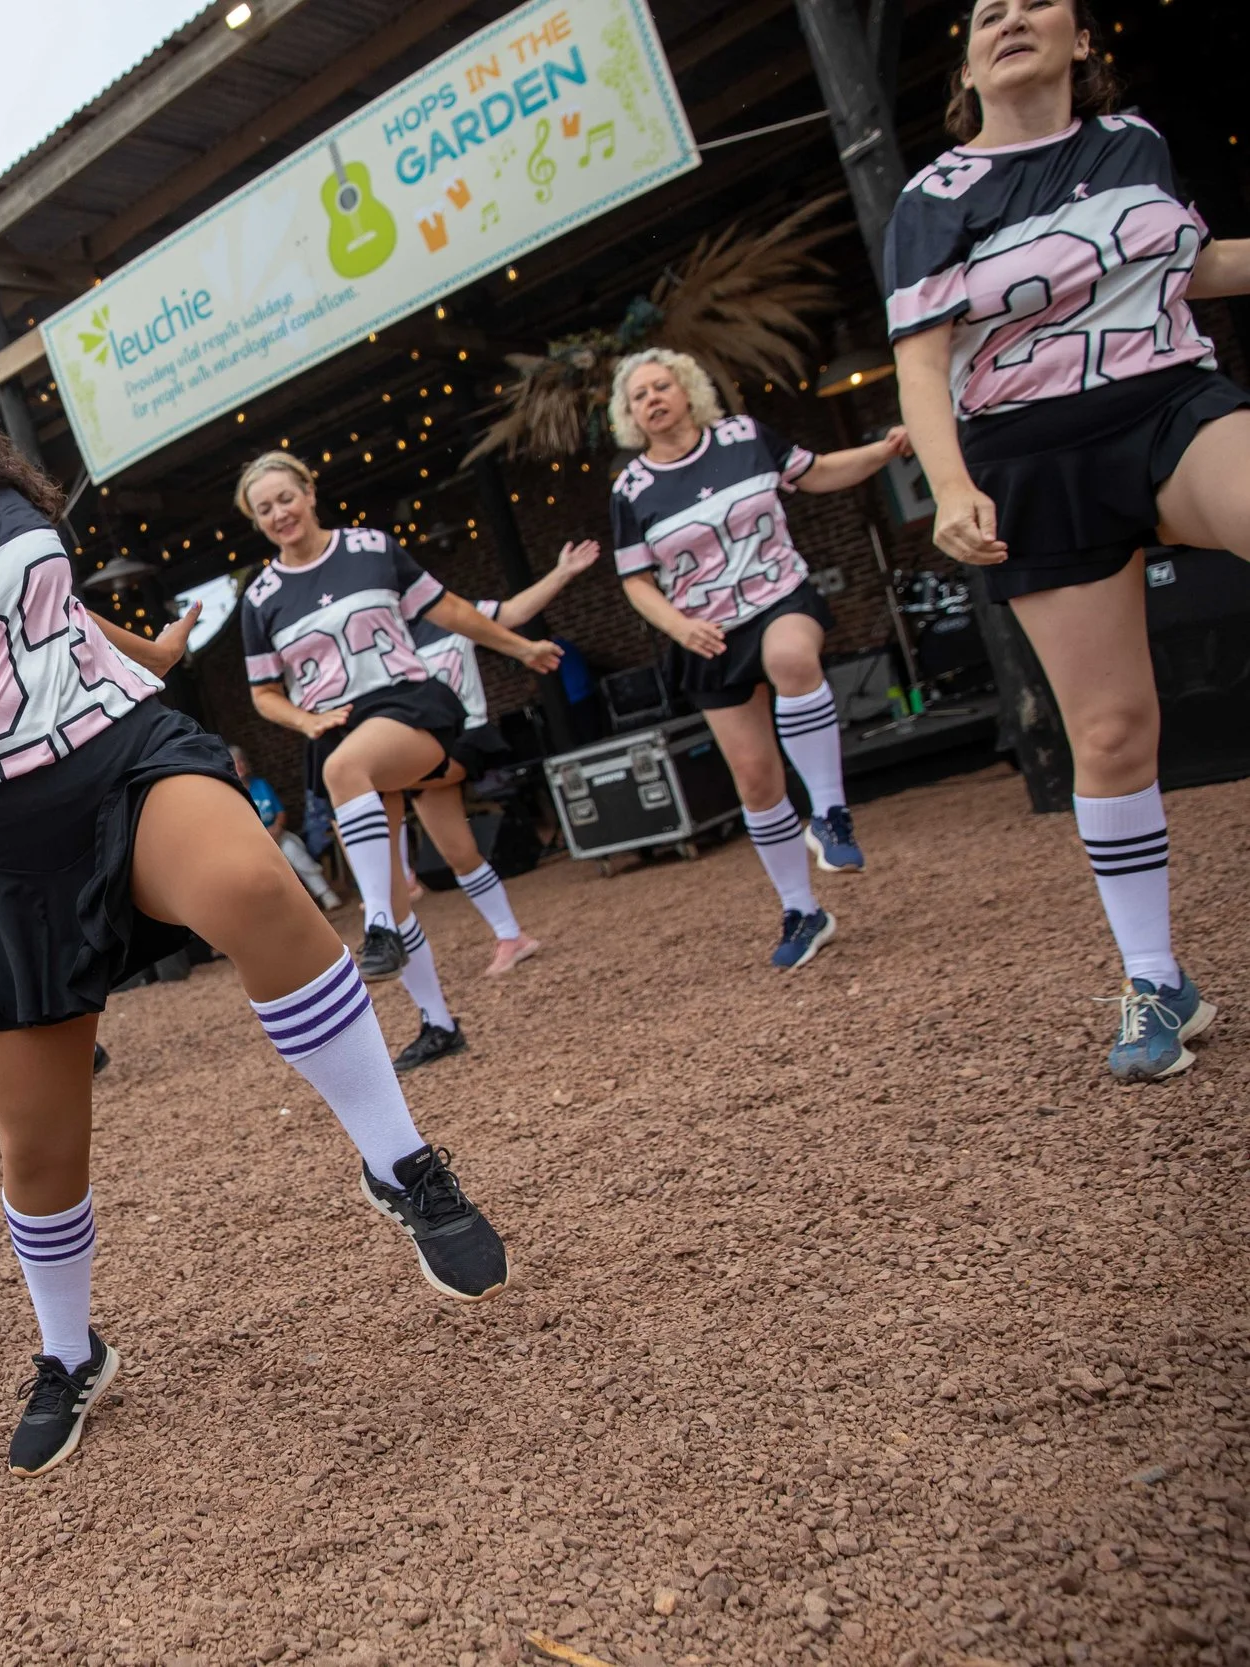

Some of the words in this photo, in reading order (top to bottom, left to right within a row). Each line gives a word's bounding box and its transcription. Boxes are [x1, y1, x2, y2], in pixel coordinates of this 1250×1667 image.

[382, 82, 458, 146] HOPS
[464, 53, 502, 95] IN
[508, 10, 572, 64] THE
[395, 44, 588, 186] GARDEN
[109, 288, 214, 371] leuchie
[959, 199, 1214, 415] 23
[187, 363, 213, 389] with
[651, 486, 808, 623] 23
[279, 606, 430, 713] 23
